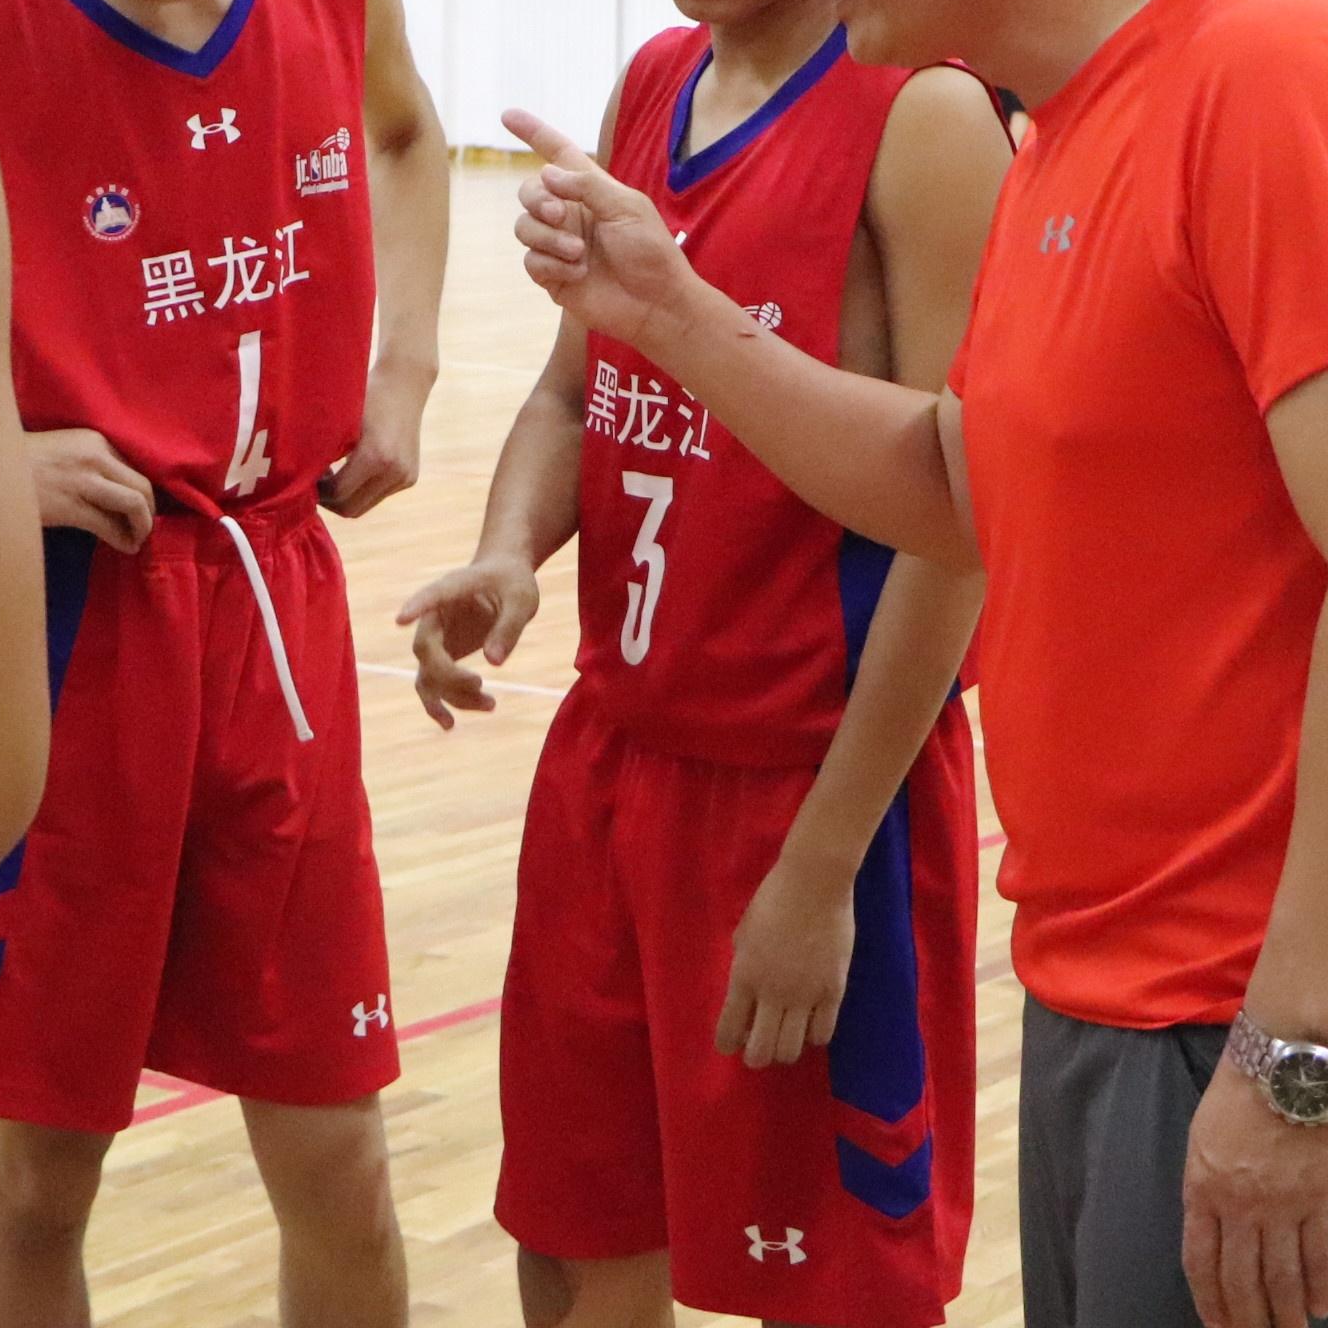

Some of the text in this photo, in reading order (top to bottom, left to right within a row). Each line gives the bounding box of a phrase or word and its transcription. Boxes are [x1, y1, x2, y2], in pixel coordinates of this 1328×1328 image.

[322, 147, 348, 179] nba
[142, 220, 310, 326] 黑龙江
[224, 330, 272, 497] 4
[586, 359, 710, 460] 黑龙江
[620, 470, 673, 666] 3
